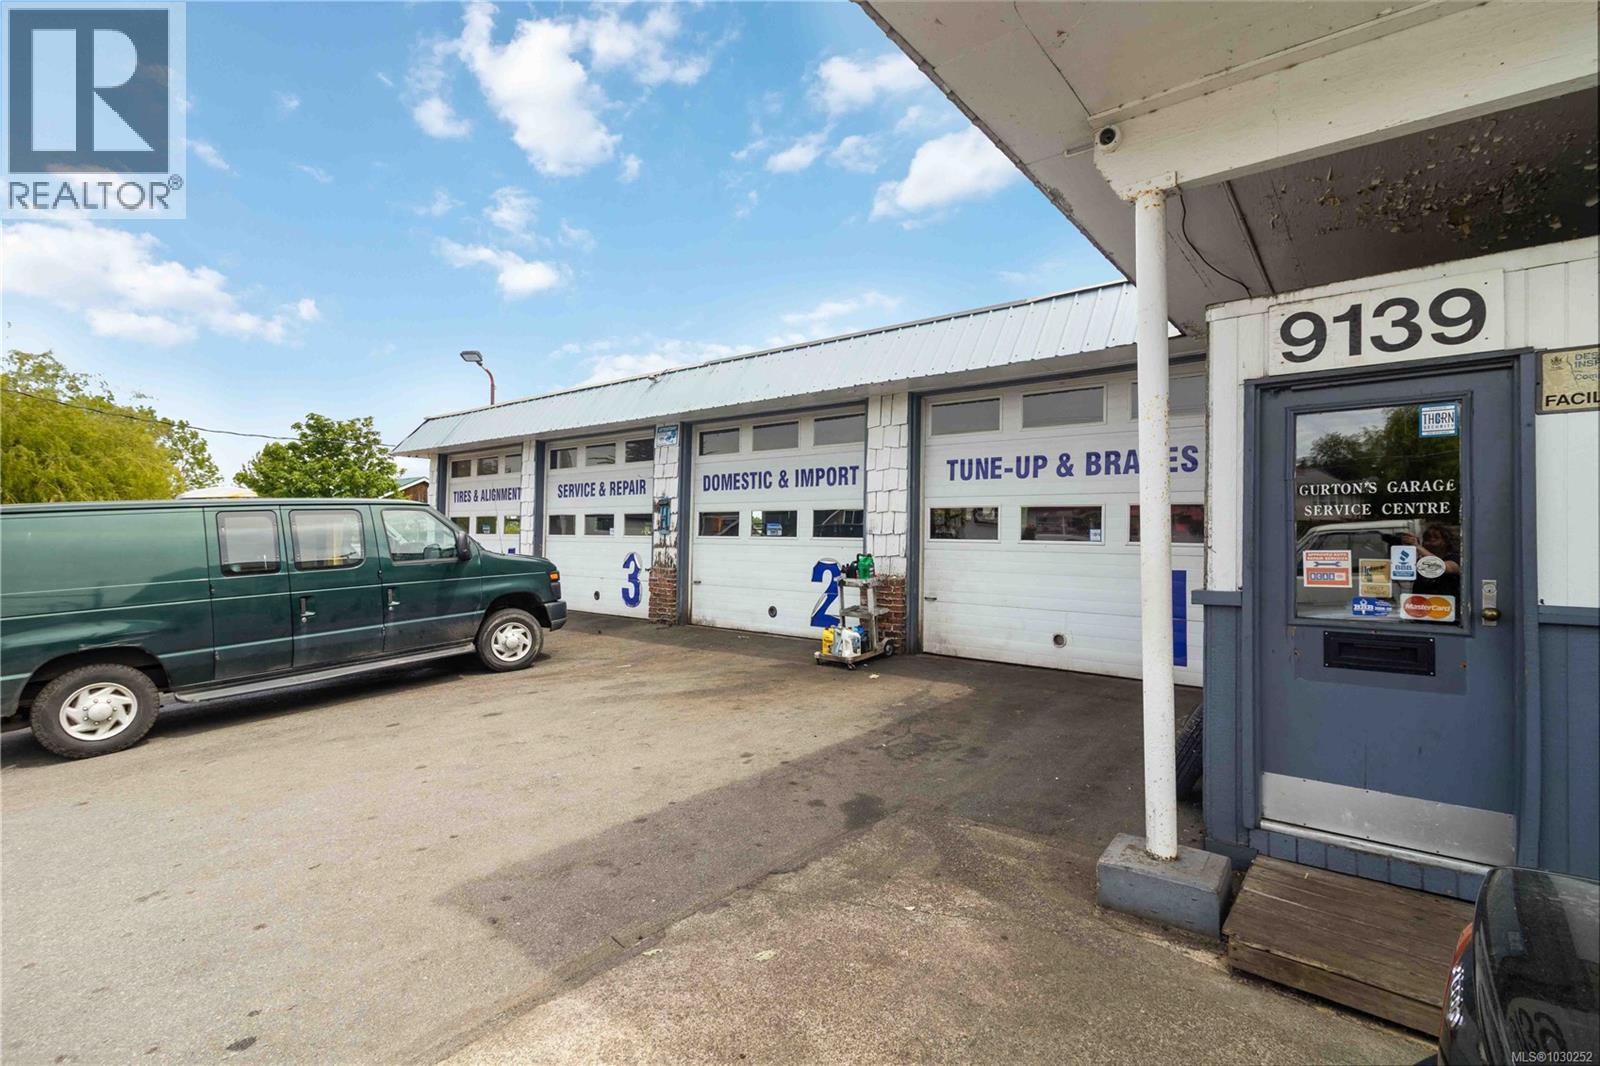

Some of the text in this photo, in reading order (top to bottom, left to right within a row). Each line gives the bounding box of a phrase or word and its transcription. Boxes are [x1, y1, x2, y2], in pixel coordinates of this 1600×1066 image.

[1279, 287, 1487, 363] 9139
[1545, 391, 1600, 407] FACIL
[1423, 411, 1455, 425] THORN
[946, 444, 1199, 482] TUNE-UP & BRAES
[703, 465, 860, 492] DOMESTIC & IMPORT
[1299, 479, 1457, 497] GURTON'S GARAGE
[453, 486, 522, 504] TIRES & ALIGNMENT
[557, 479, 647, 499] SERVICE & REPAIR
[1304, 501, 1451, 517] SERVICE CENTRE
[621, 552, 643, 608] 3
[810, 558, 841, 628] 2
[1404, 603, 1451, 613] MasterCard
